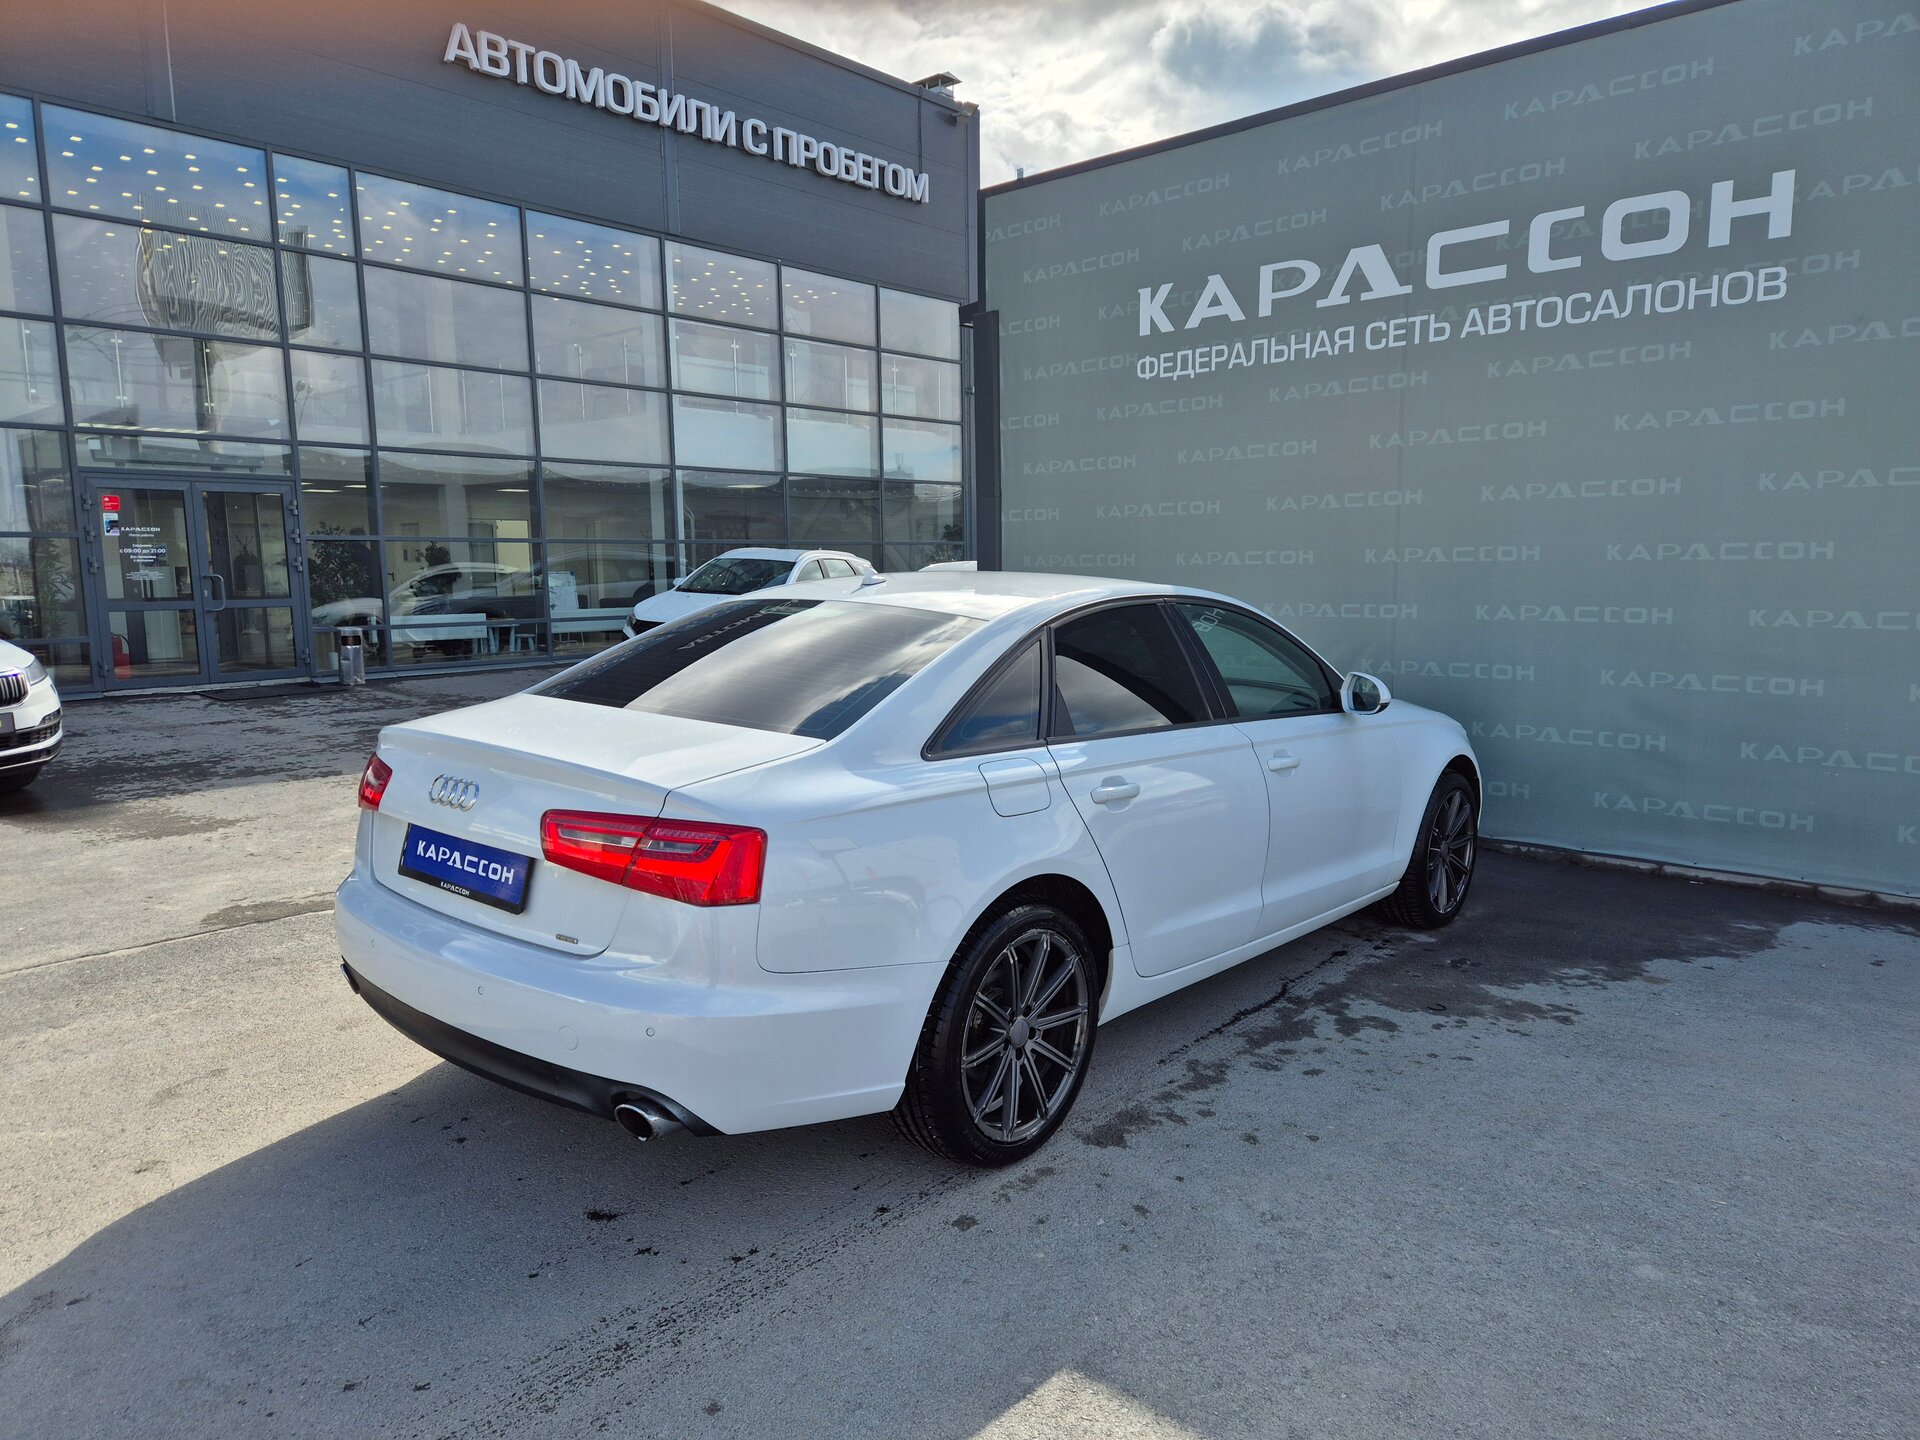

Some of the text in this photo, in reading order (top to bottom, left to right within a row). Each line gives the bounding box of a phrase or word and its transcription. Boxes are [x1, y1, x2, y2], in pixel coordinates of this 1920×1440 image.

[1504, 57, 1714, 121] КАРАССОН
[443, 22, 929, 203] АВТОМОБИЛИ С ПРОБЕГОМ
[1634, 97, 1873, 161] КАРАССОН
[1277, 120, 1443, 176] КАРАССОН
[1380, 157, 1566, 212] КАРАССОН
[1182, 208, 1327, 252] КАРАССОН
[1023, 248, 1140, 285] КАРАССОН
[1137, 169, 1796, 337] КАРАССОН
[1137, 324, 1355, 381] ФЕДЕРАЛЬНАЯ
[1365, 313, 1451, 351] СЕТЬ
[1460, 266, 1788, 339] АВТОСАЛОНОВ
[1487, 341, 1692, 378] КАРАССОН
[1269, 370, 1428, 402] КАРАССОН
[1097, 394, 1223, 421] КАРАССОН
[1614, 398, 1846, 432] КАРАССОН
[1369, 419, 1547, 450] КАРАССОН
[1023, 454, 1136, 475] КАРАССОН
[1177, 439, 1317, 464] КАРАССОН
[1266, 489, 1422, 511] КАРАССОН
[1480, 477, 1682, 502] КАРАССОН
[1096, 500, 1221, 519] КАРАССОН
[1176, 549, 1314, 566] КАРАССОН
[1365, 544, 1541, 563] КАРАССОН
[1606, 541, 1835, 561] КАРАССОН
[1476, 604, 1673, 625] КАРАССОН
[1748, 608, 1920, 631] КАРАС
[1600, 669, 1825, 697] КАРАССОН
[1472, 721, 1666, 752] КАРАССОН
[1594, 791, 1814, 832] КАРАССОН
[417, 840, 514, 885] КАРАССОН
[440, 881, 470, 896] КАРАССОН
